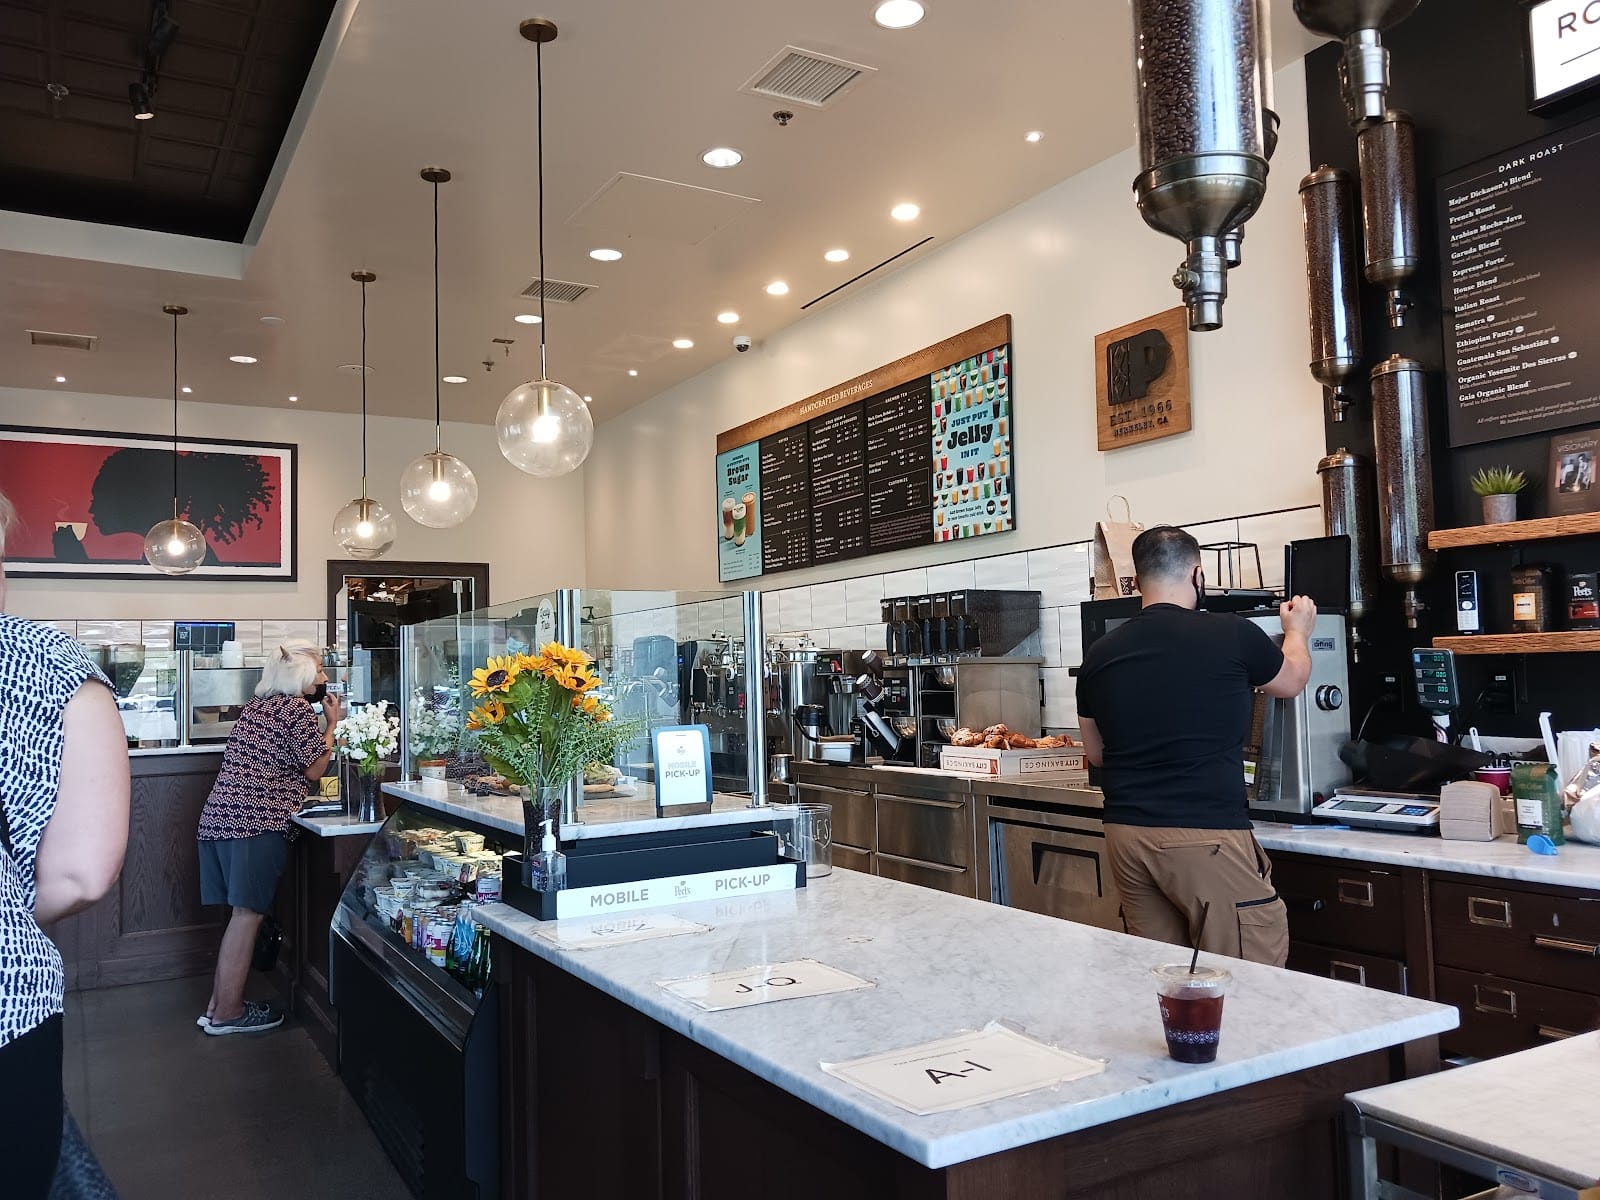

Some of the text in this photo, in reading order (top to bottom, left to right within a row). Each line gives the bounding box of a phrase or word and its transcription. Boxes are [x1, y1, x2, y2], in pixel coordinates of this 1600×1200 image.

[1498, 143, 1564, 173] DARK ROAST
[1449, 195, 1469, 206] Major
[1470, 181, 1508, 199] Dickason's
[1449, 211, 1474, 224] French
[1475, 204, 1496, 215] Roast
[1450, 229, 1478, 241] Arabian
[1480, 214, 1522, 232] Mocha-Java
[1451, 247, 1477, 259] Garuda
[1452, 264, 1484, 277] Espresso
[1453, 284, 1475, 295] House
[1476, 276, 1498, 288] Blend
[1454, 302, 1478, 313] Italian
[1480, 295, 1500, 306] Roast
[1455, 318, 1485, 331] Sumatra
[1456, 329, 1514, 348] Ethiopian Fancy
[1457, 351, 1495, 366] Guatemala
[1496, 349, 1510, 357] San
[1458, 355, 1567, 384] Organic Yosemite Dos Sierras
[799, 379, 873, 416] HANDCRAFTED BEVERAGES
[1459, 393, 1475, 402] Gaia
[1476, 387, 1505, 398] Organic
[1142, 400, 1172, 418] 1966
[951, 410, 989, 428] JUST PUT
[1157, 415, 1168, 425] CA
[947, 423, 993, 450] Jelly
[960, 447, 980, 459] IN IT
[1557, 440, 1599, 453] VISIONARY
[727, 463, 750, 477] Brown
[728, 472, 749, 487] Sugar
[668, 760, 697, 769] MOBILE
[1035, 760, 1064, 768] BAKING
[665, 769, 700, 779] PICK-UP
[715, 874, 771, 891] PICK-UP
[590, 888, 649, 908] MOBILE
[924, 1060, 992, 1085] A-I
